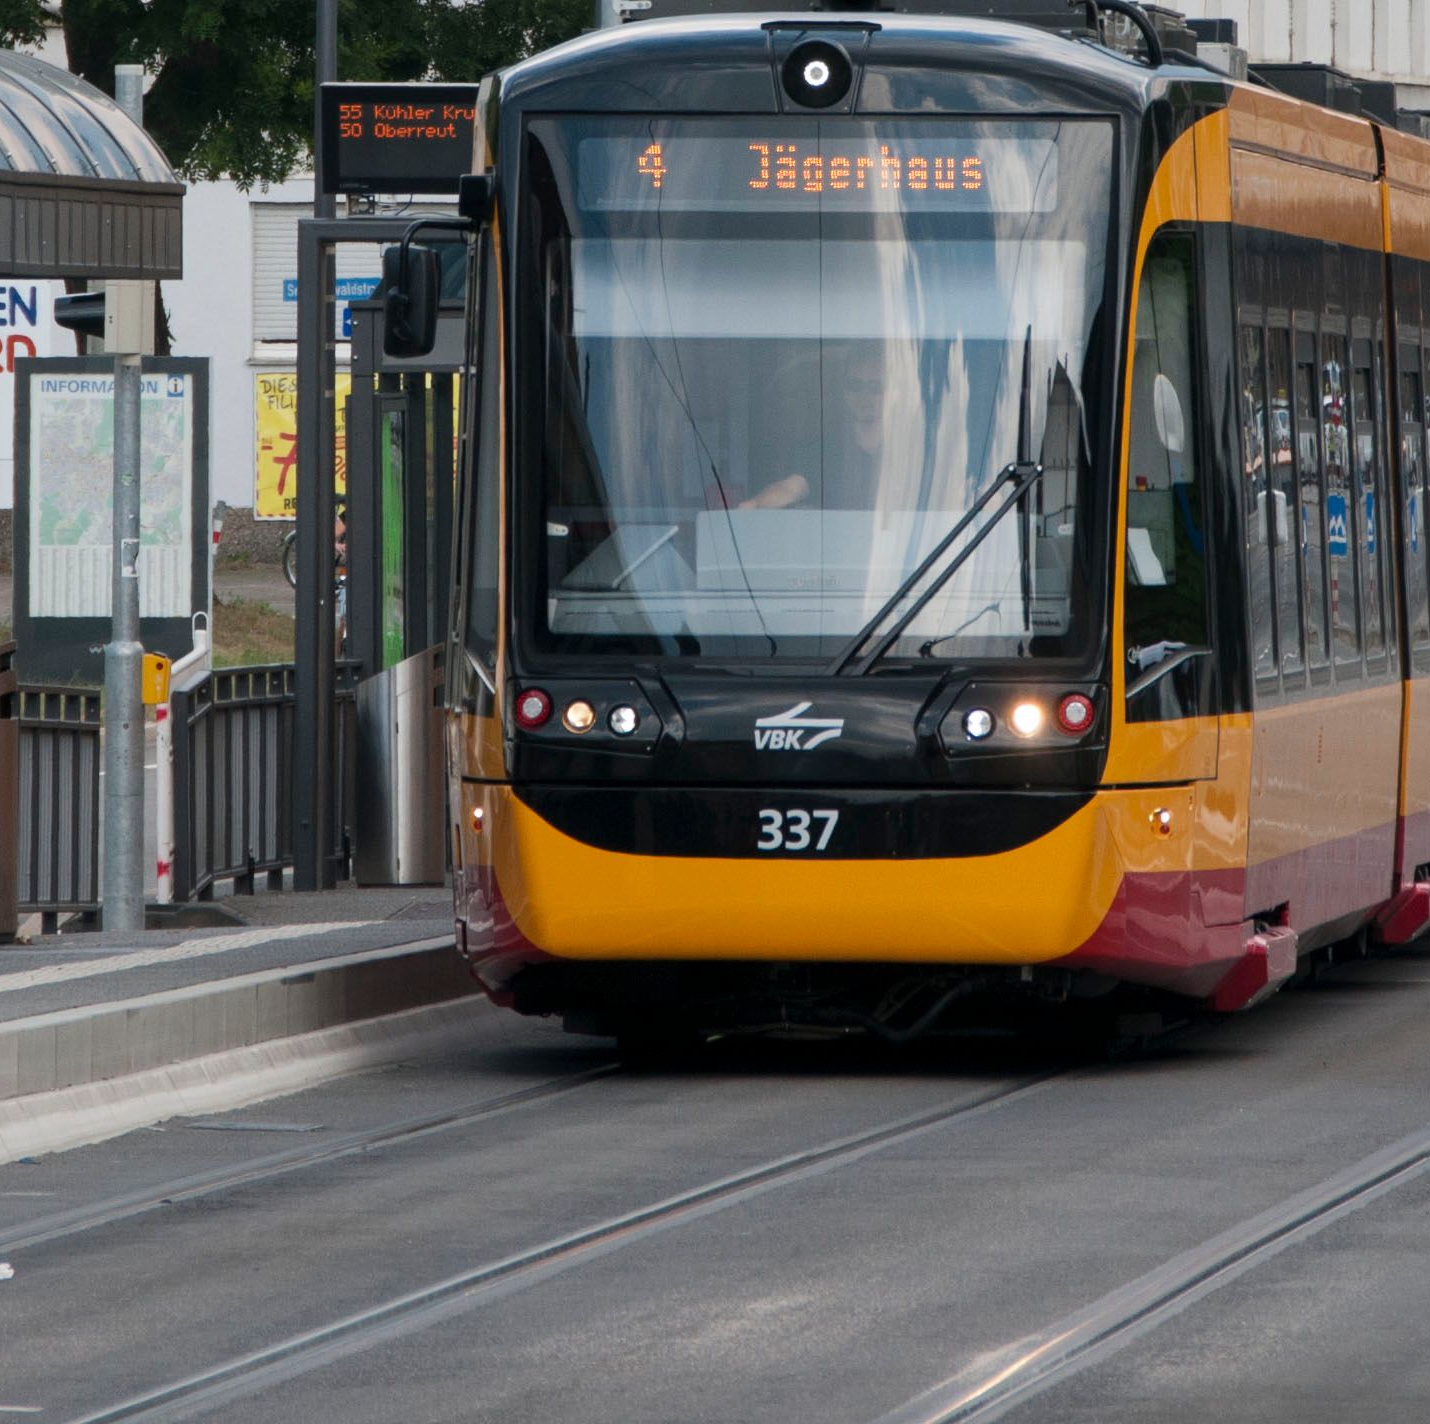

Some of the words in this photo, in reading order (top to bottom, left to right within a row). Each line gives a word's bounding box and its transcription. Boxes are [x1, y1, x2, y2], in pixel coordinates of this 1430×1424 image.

[339, 104, 363, 121] 55
[374, 104, 435, 121] Kühler
[339, 123, 363, 139] 50
[374, 122, 457, 139] Oberreut
[637, 144, 667, 188] 4
[748, 144, 983, 193] Jägerhaus
[41, 380, 158, 393] INFORMAON
[754, 729, 805, 750] VBK
[757, 808, 840, 851] 337
